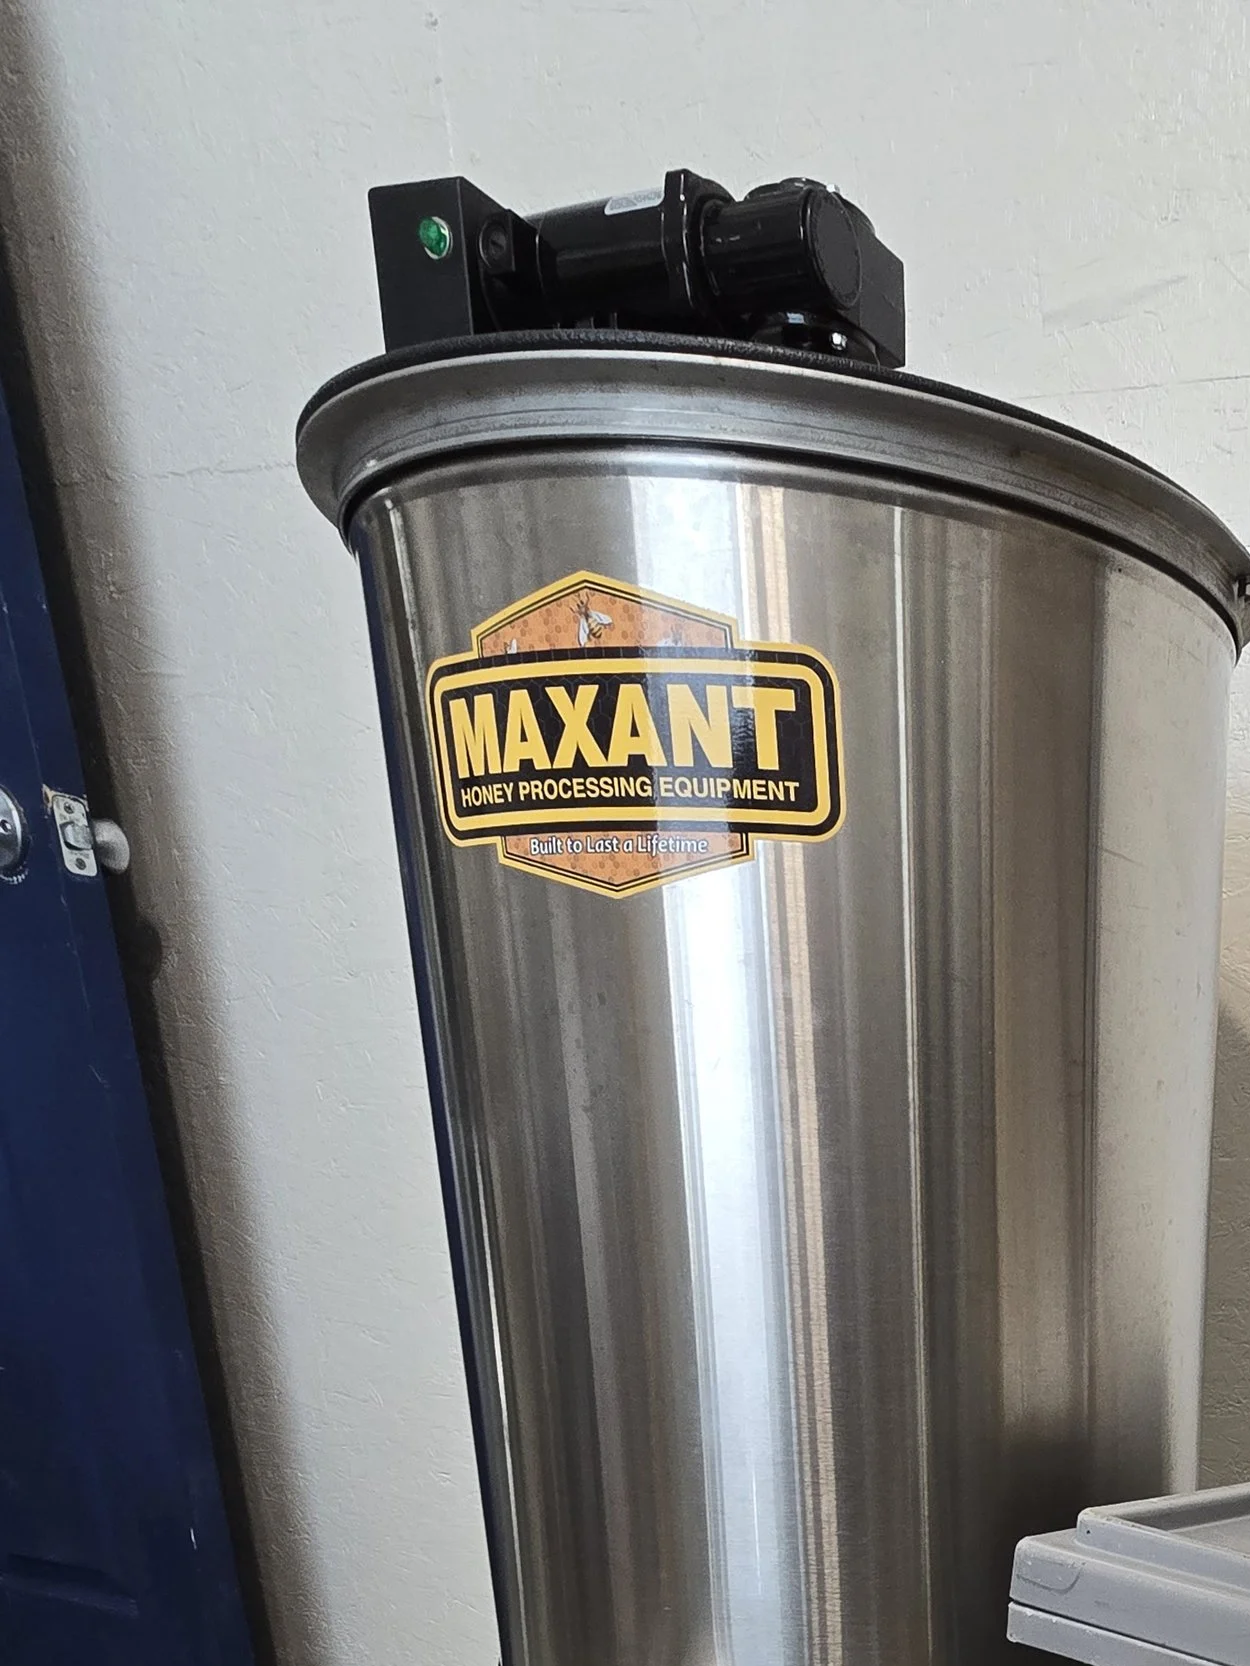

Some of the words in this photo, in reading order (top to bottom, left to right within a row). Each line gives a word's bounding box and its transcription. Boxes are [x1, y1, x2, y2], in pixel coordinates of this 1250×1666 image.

[448, 683, 796, 779] MAXANT
[460, 782, 514, 808] HONEY
[518, 776, 653, 801] PROCESSING
[659, 776, 800, 802] EQUIPMENT
[530, 836, 562, 855] Built
[567, 839, 583, 853] to
[587, 836, 618, 853] Last
[623, 839, 633, 852] a
[637, 833, 708, 856] Lifetime
